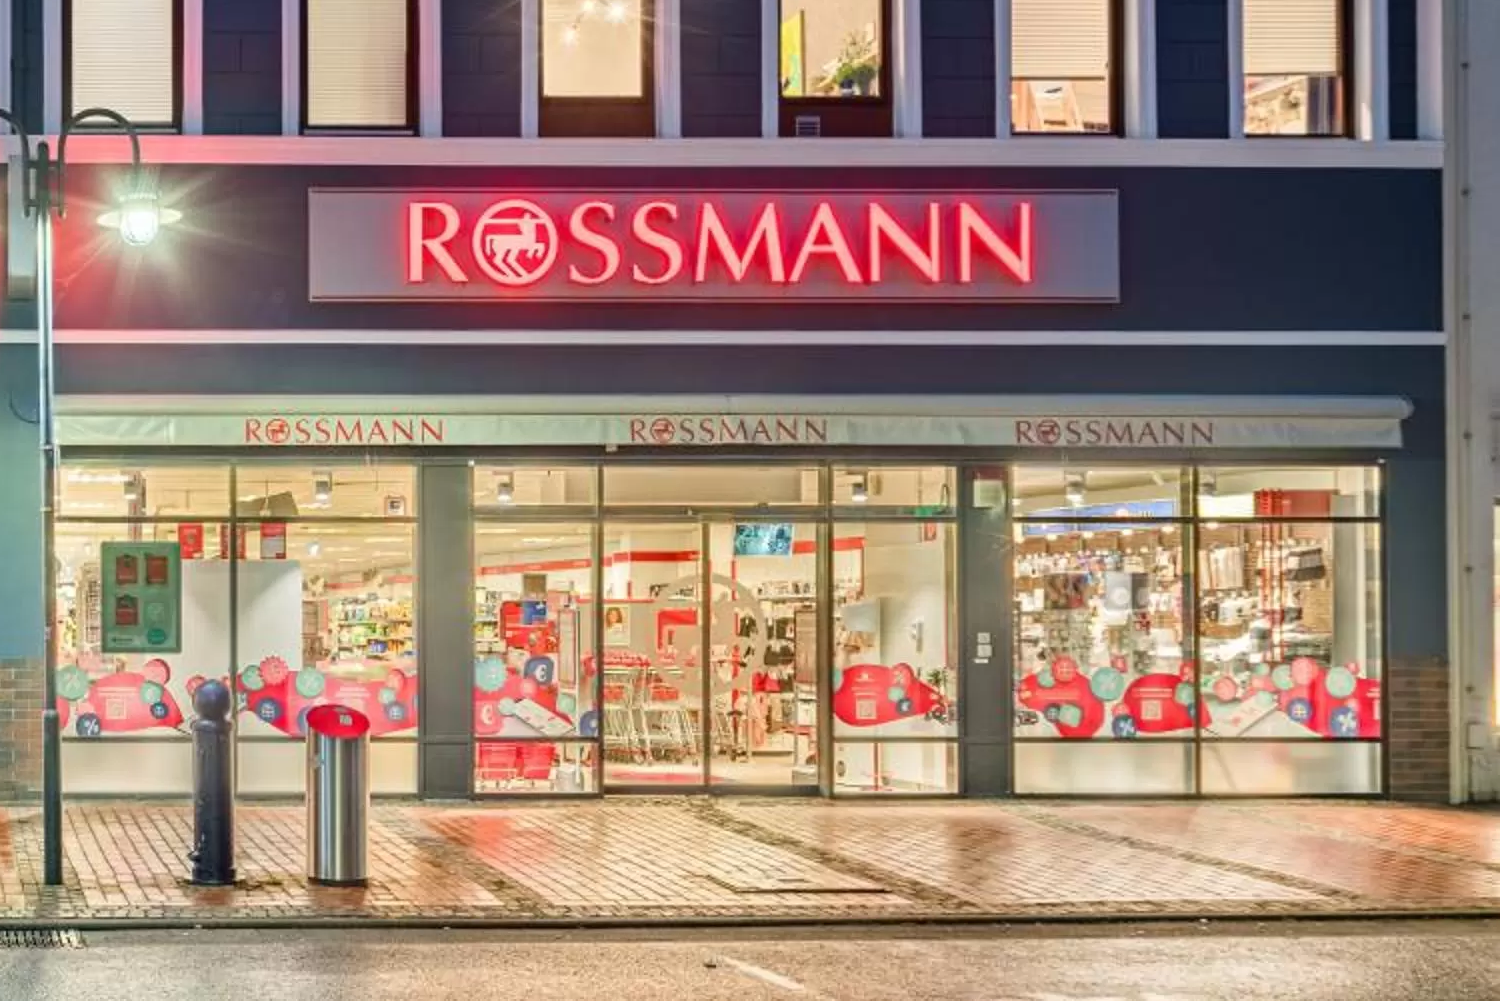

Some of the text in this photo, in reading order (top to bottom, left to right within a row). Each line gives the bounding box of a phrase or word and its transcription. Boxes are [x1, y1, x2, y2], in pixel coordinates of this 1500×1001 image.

[407, 198, 1033, 286] ROSSMANN
[245, 418, 444, 446] ROSSMANN
[630, 417, 827, 445] ROSSMANN
[1015, 419, 1214, 446] ROSSMANN
